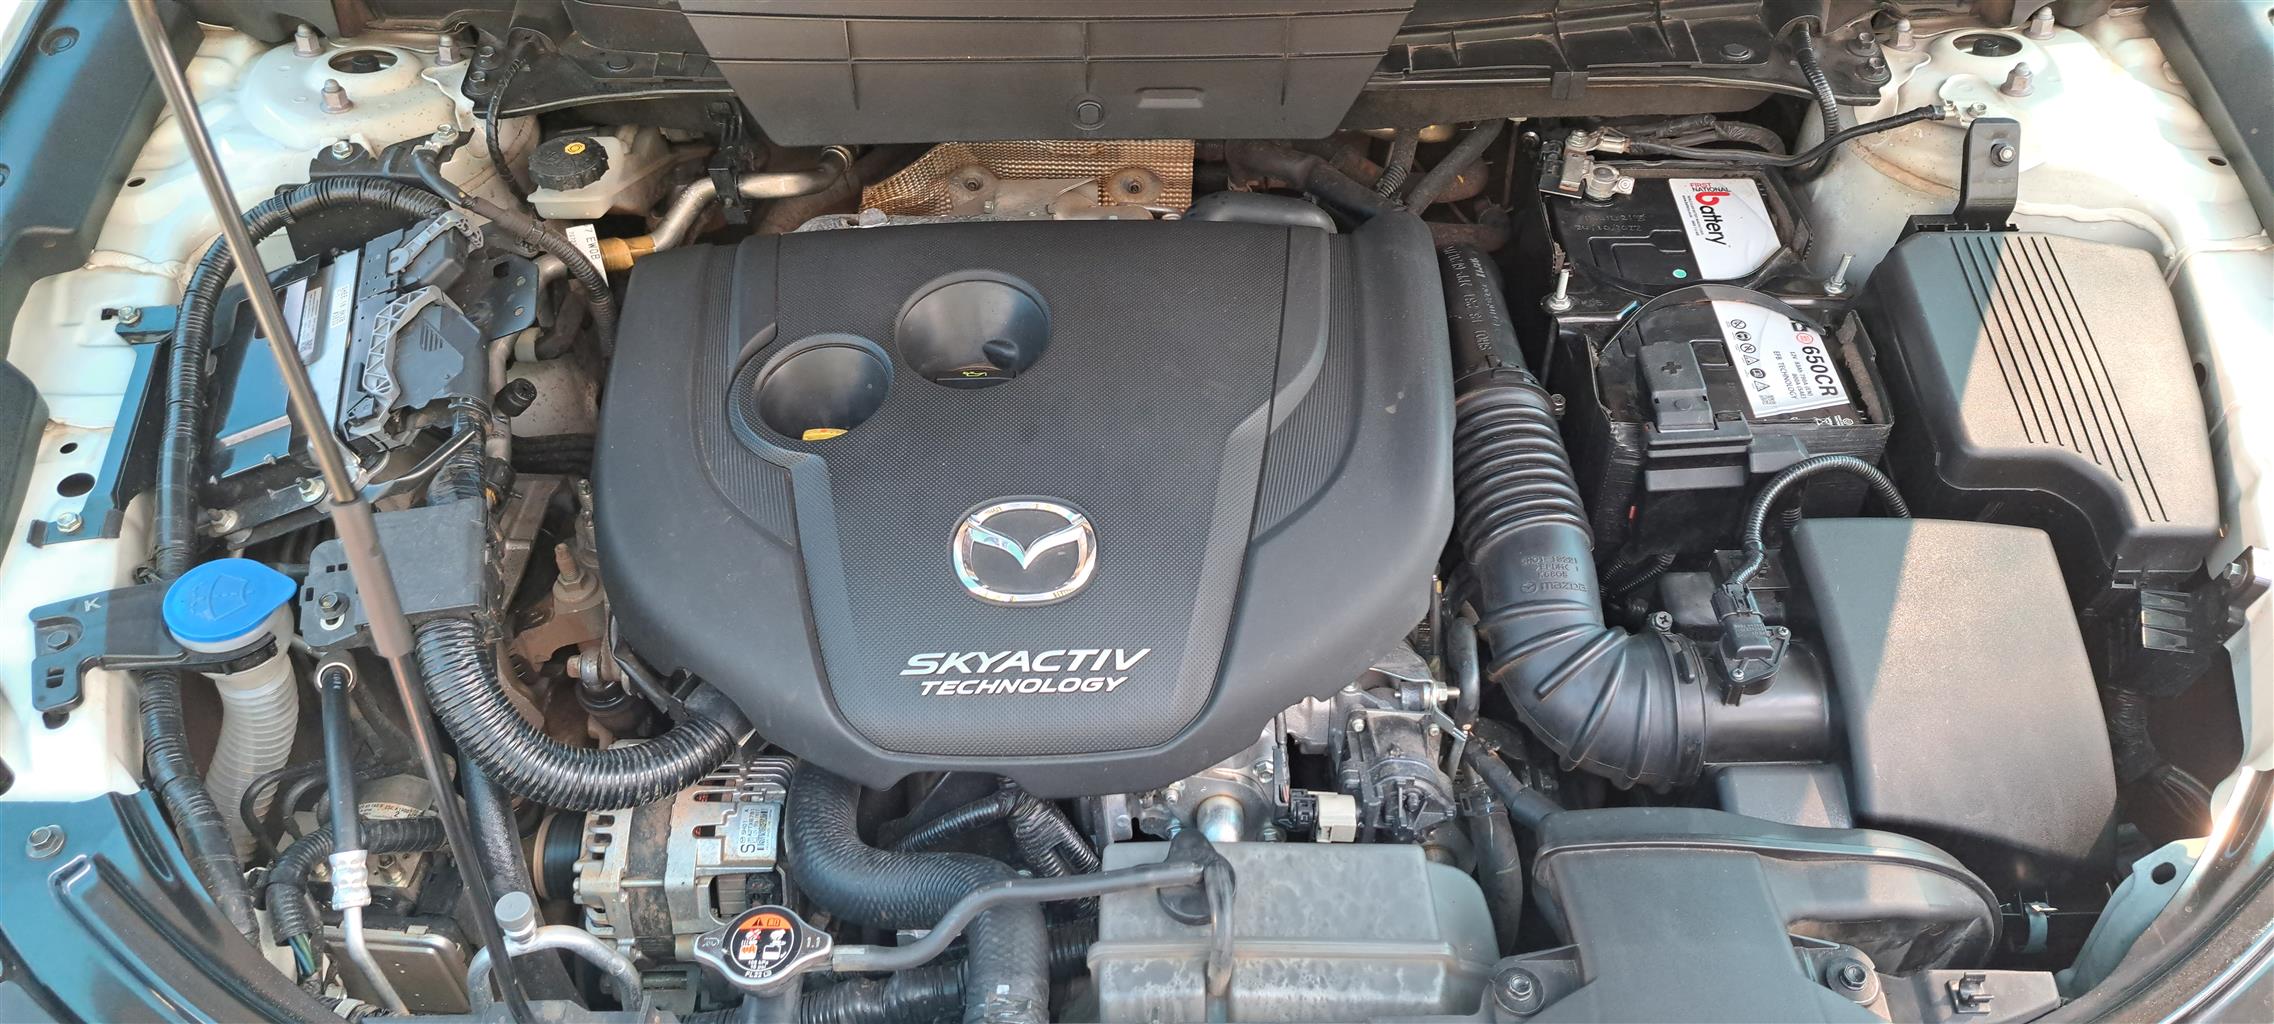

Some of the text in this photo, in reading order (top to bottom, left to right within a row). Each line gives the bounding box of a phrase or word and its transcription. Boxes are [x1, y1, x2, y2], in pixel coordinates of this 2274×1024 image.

[1695, 191, 1730, 246] battery
[1778, 362, 1798, 400] TECHNOLOGY
[1802, 346, 1838, 396] 650CR
[85, 596, 101, 612] K
[900, 648, 1152, 676] SKYACTIV
[920, 676, 1129, 697] TECHNOLOGY
[740, 843, 756, 854] S
[806, 936, 821, 949] 1.1
